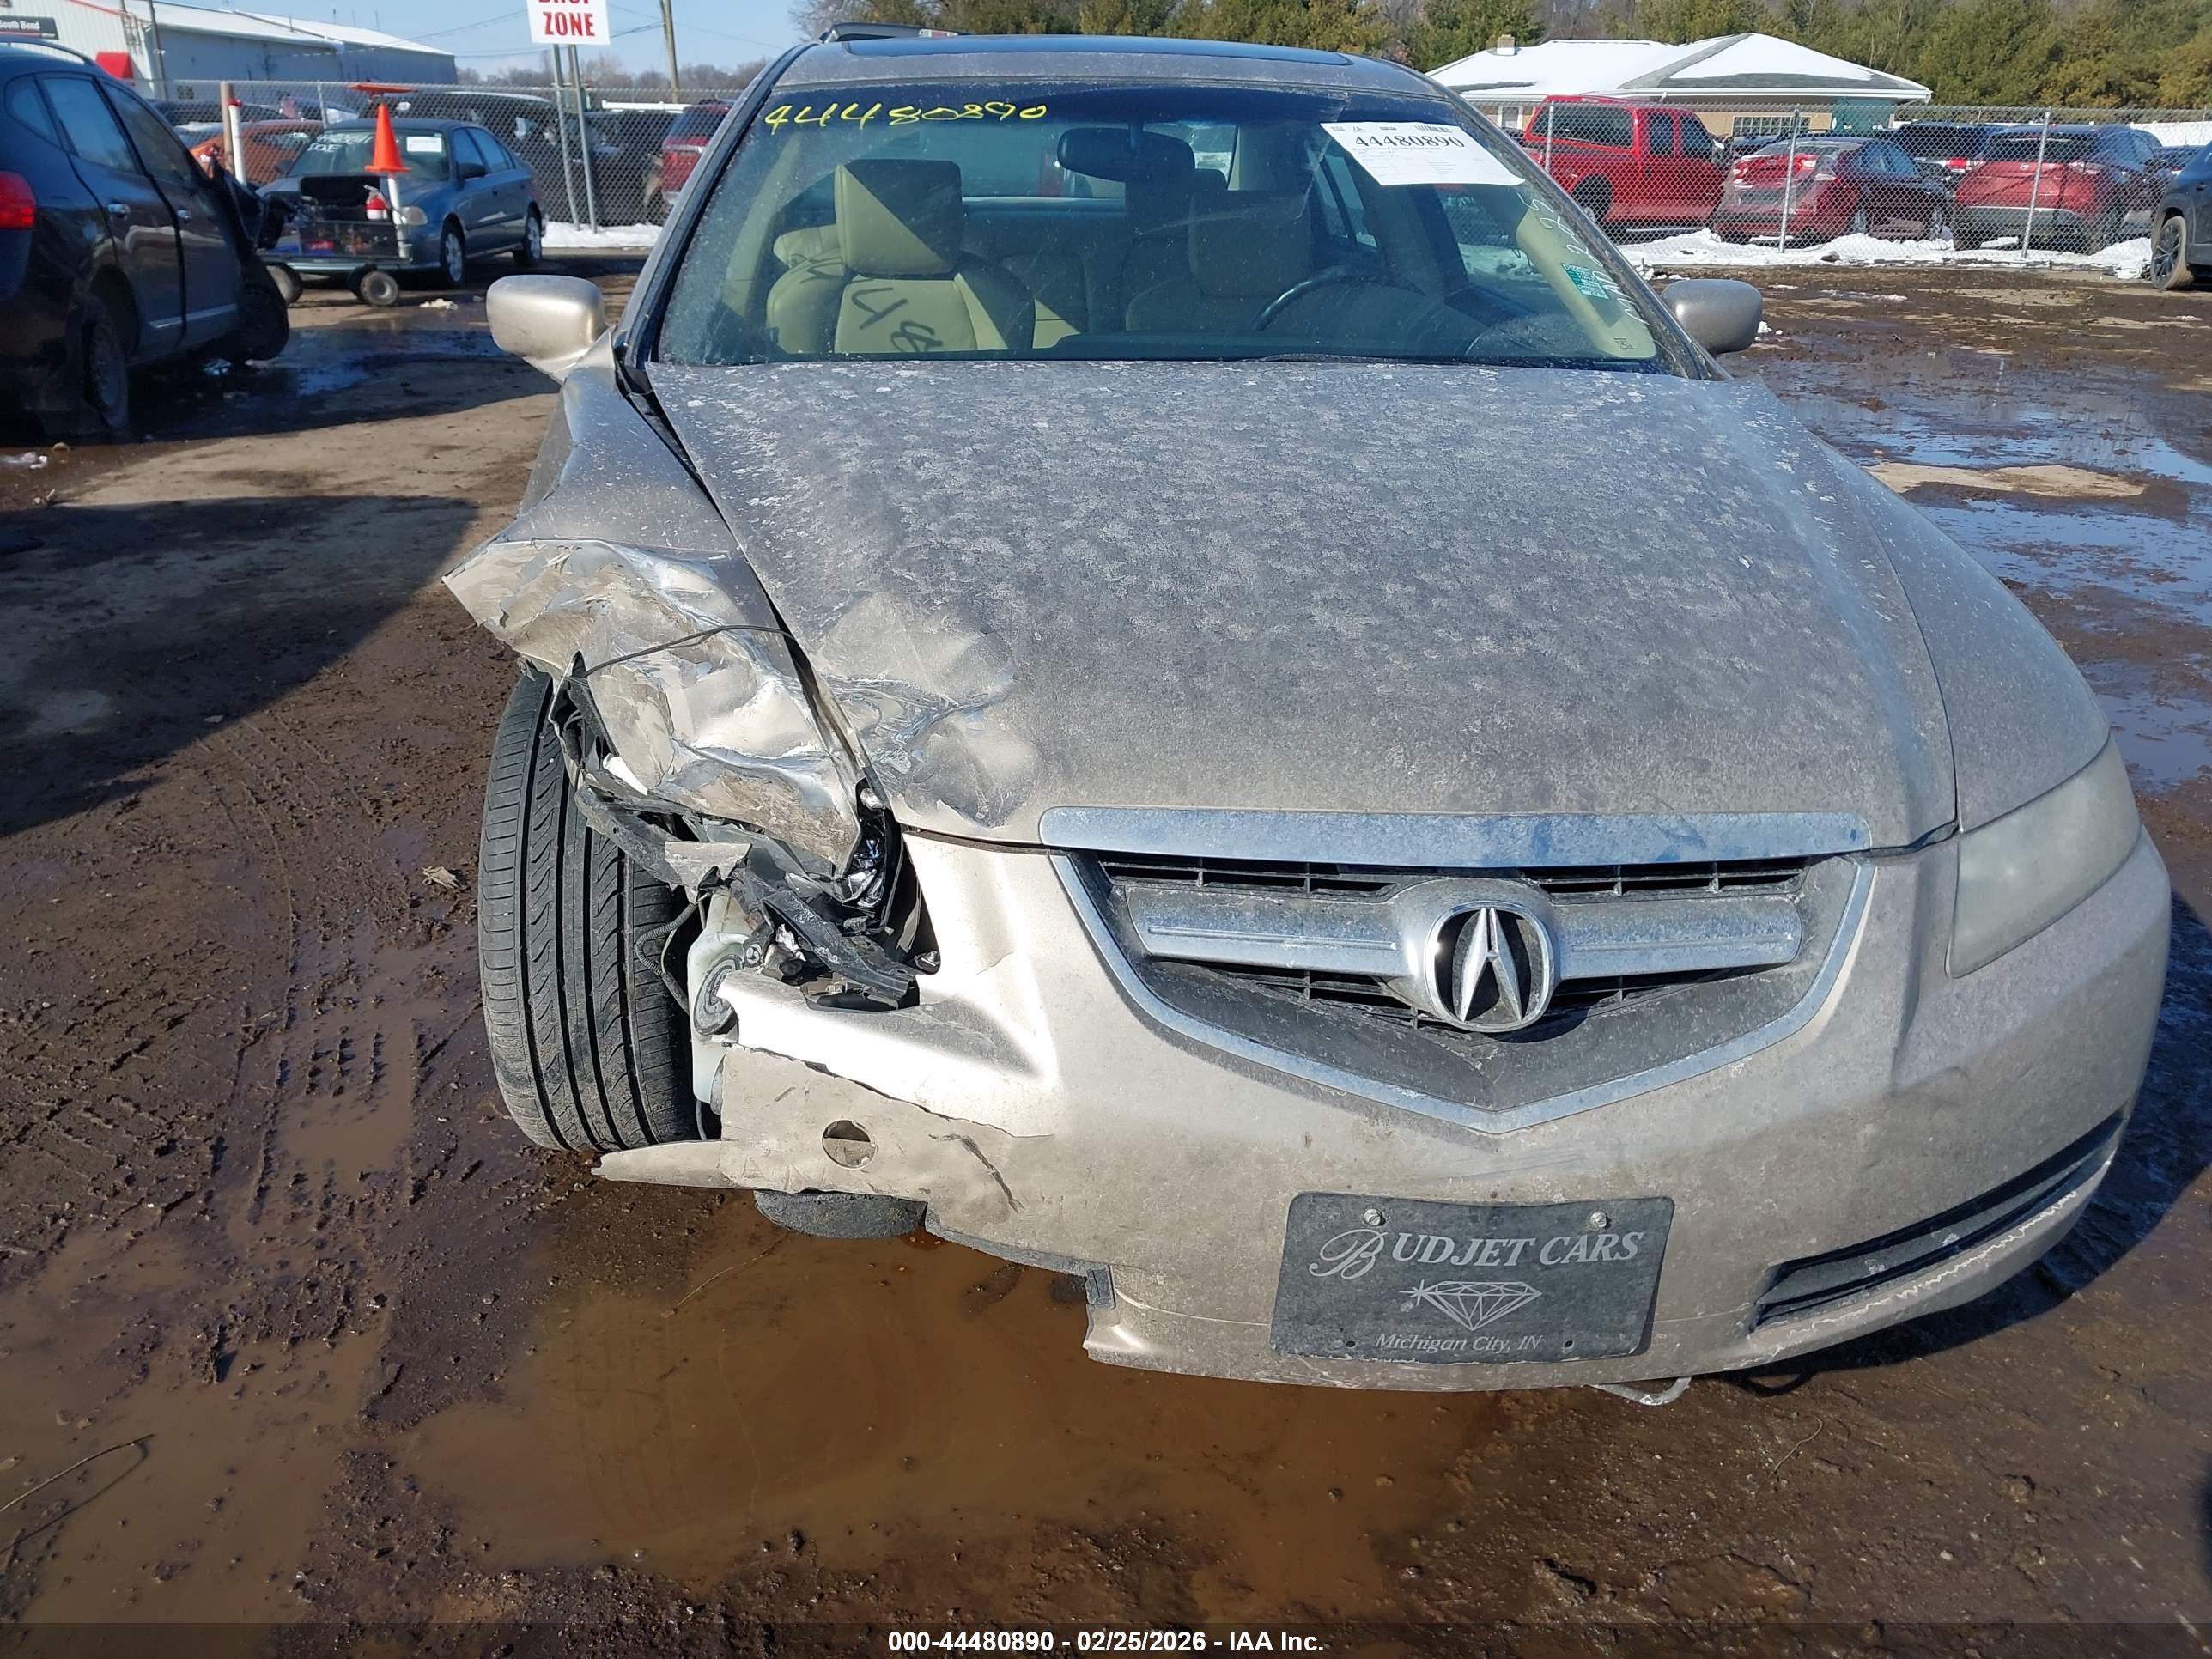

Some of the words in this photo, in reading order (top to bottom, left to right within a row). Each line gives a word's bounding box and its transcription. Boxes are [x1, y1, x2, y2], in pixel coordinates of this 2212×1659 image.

[20, 20, 40, 31] Bend
[543, 11, 595, 36] ZONE
[764, 102, 1048, 136] 44480890
[1355, 135, 1465, 148] 44480890
[1308, 1229, 1535, 1280] BUDJET
[1539, 1231, 1644, 1266] CARS
[1375, 1333, 1467, 1353] Michigan
[1472, 1334, 1511, 1354] City,
[1518, 1334, 1545, 1351] IN
